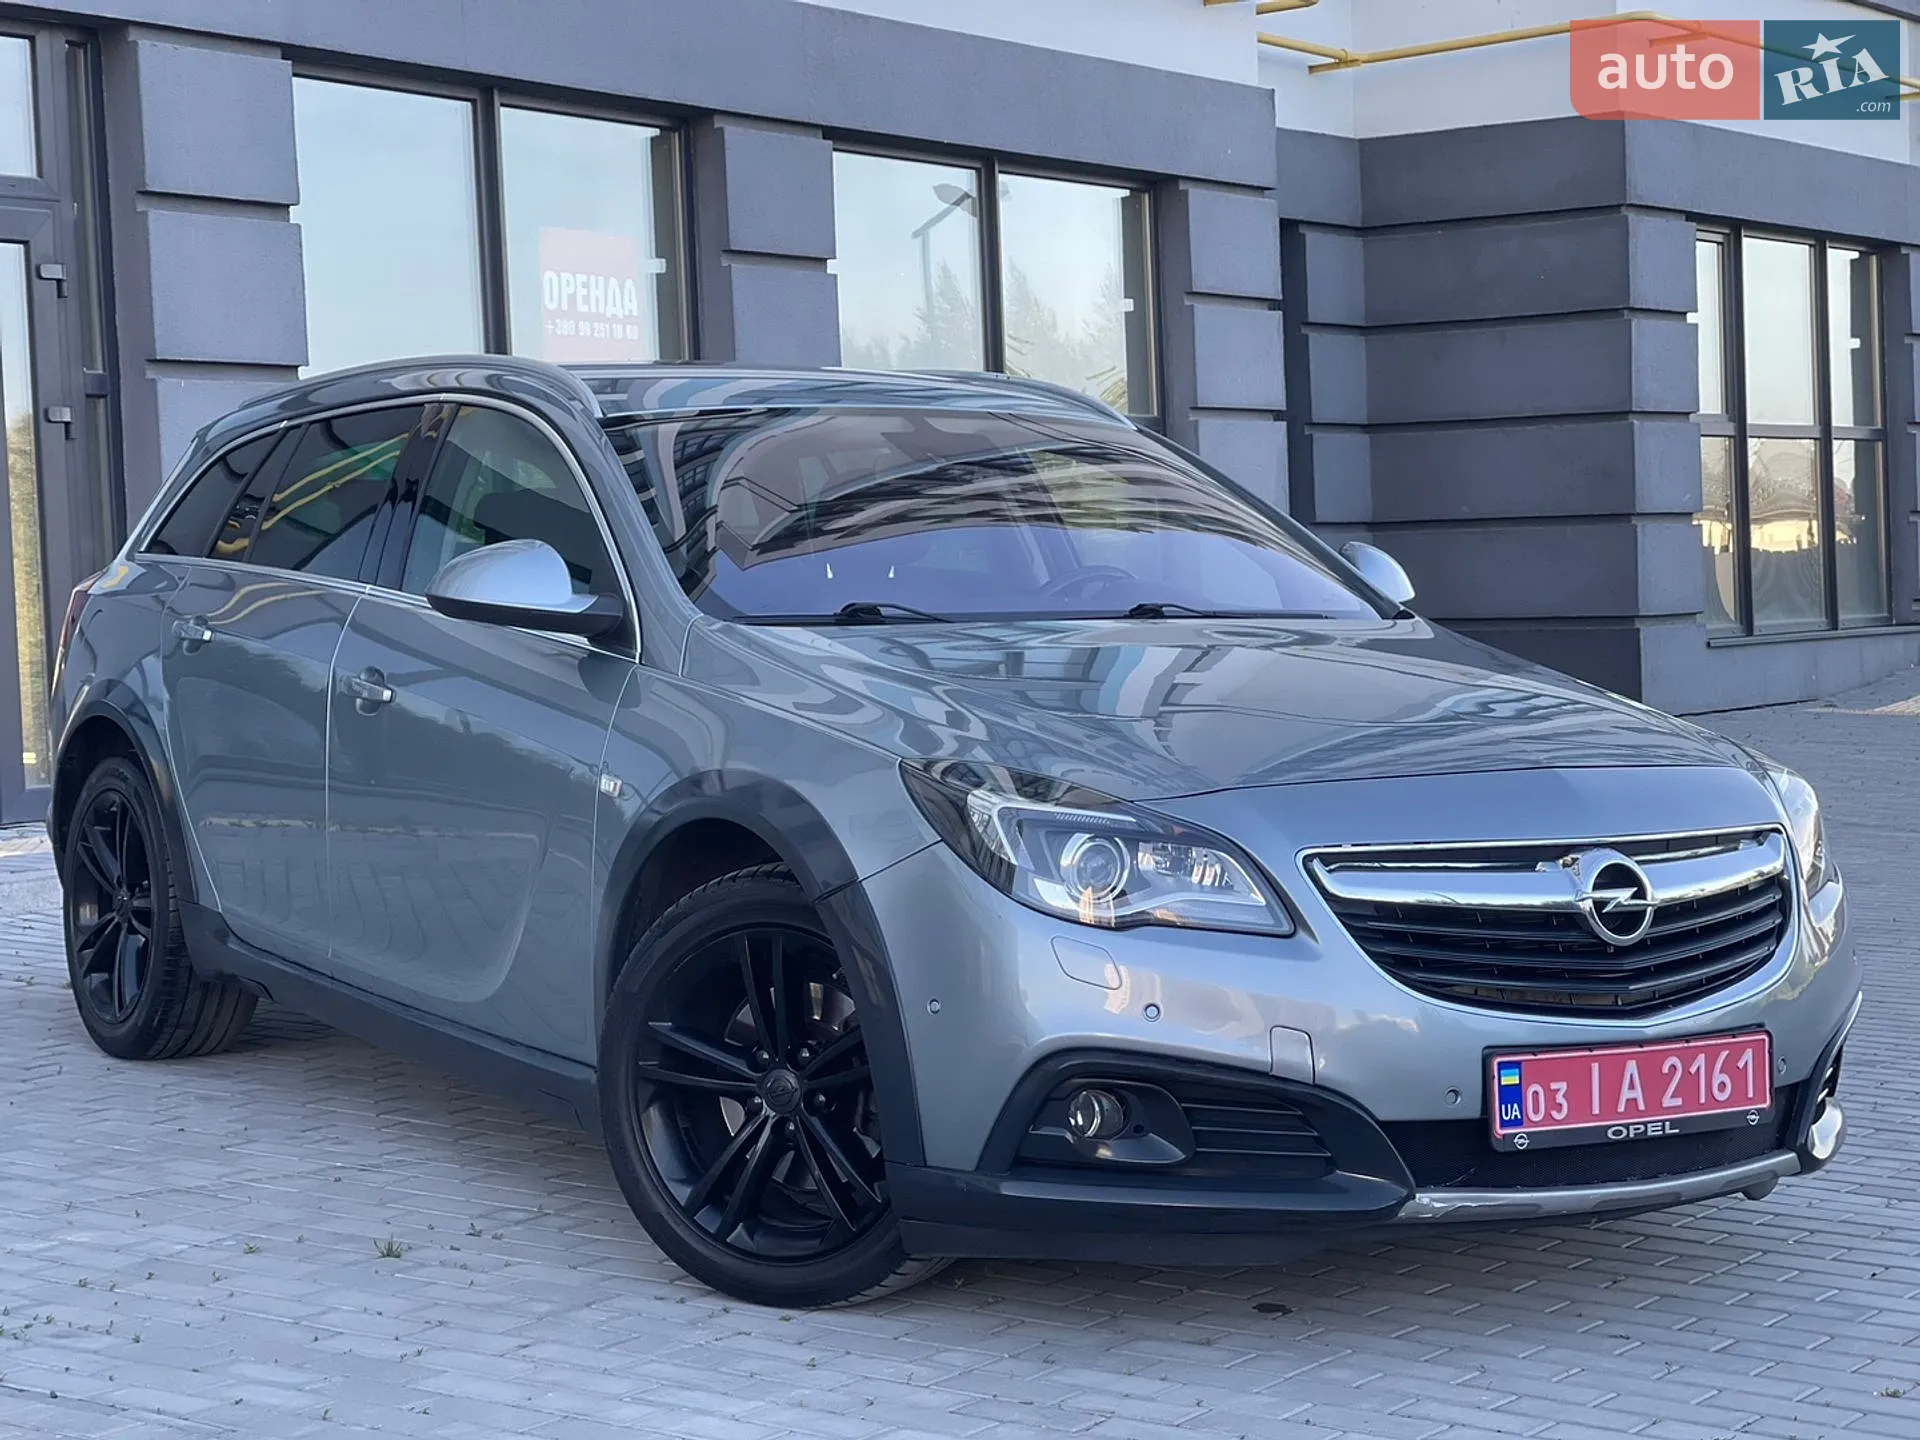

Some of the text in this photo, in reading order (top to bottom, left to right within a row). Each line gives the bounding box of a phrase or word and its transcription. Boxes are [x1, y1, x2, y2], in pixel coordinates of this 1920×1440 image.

[543, 271, 638, 319] ОРЕНДА
[1526, 1081, 1568, 1123] 03
[1661, 1048, 1754, 1109] 2161
[1501, 1103, 1521, 1121] UA
[1607, 1121, 1680, 1140] OPEL
